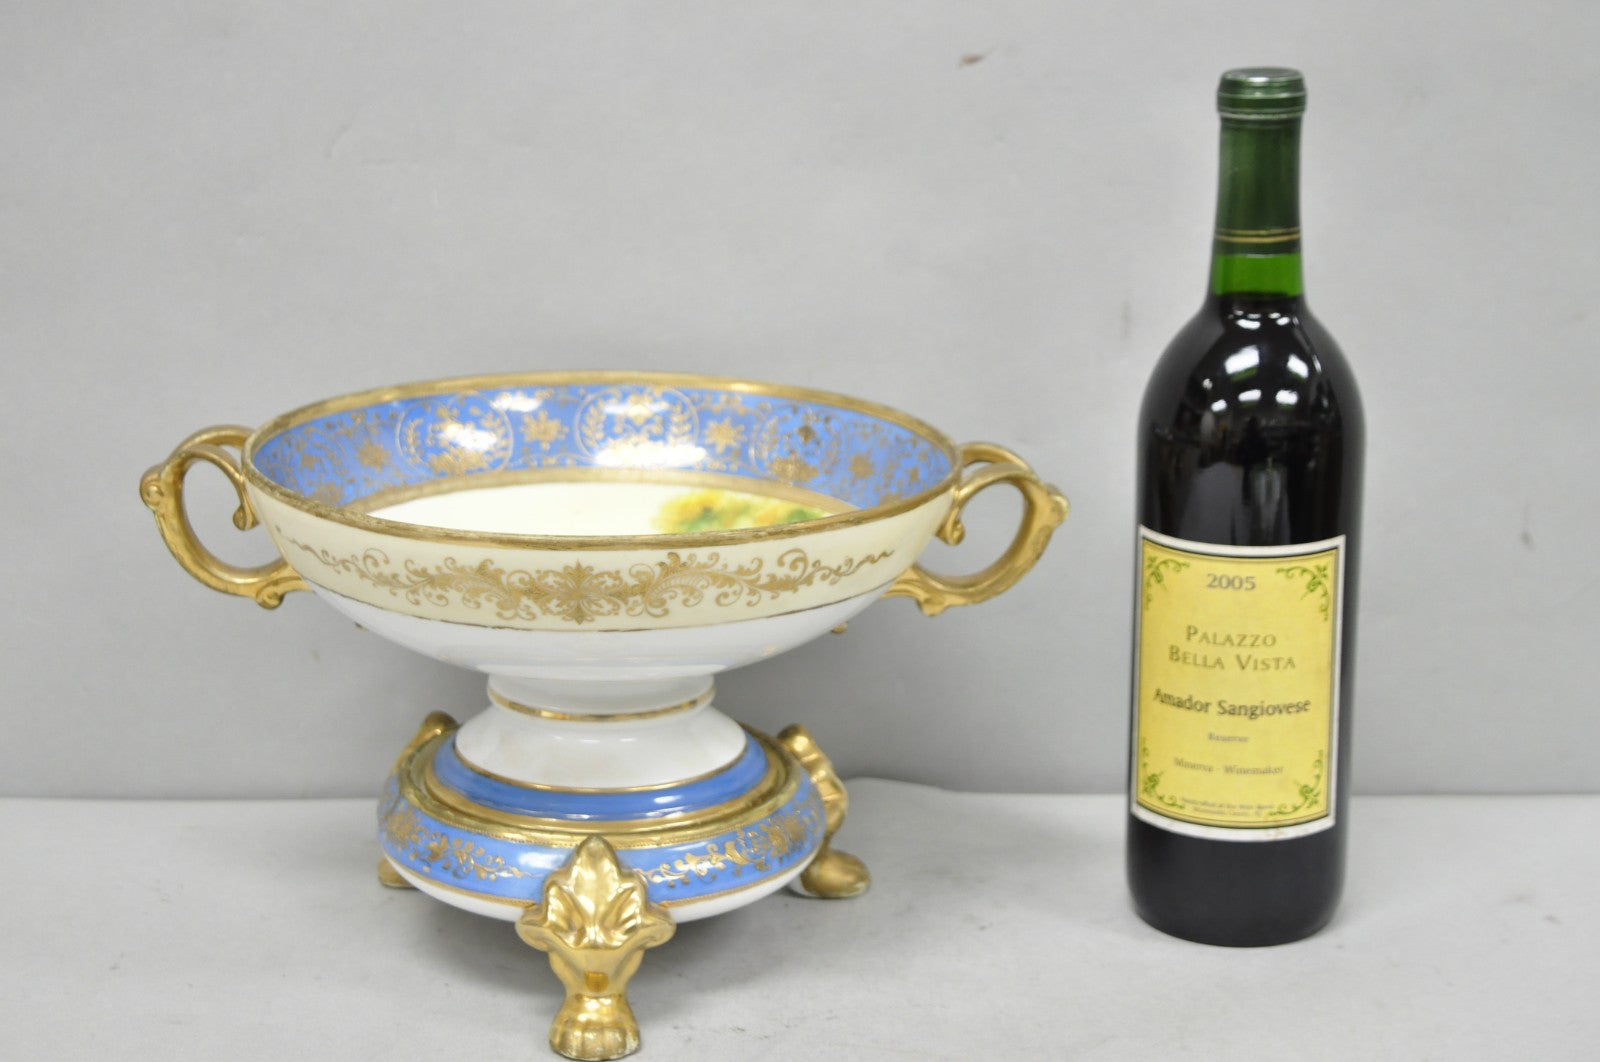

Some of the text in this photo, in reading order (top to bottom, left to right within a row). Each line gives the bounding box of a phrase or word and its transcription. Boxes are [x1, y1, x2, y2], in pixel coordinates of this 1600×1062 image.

[1206, 573, 1256, 591] 2005
[1186, 625, 1277, 647] PALAZZO
[1169, 645, 1296, 671] BELLA VISTA
[1154, 688, 1311, 720] Amador Sangiovese
